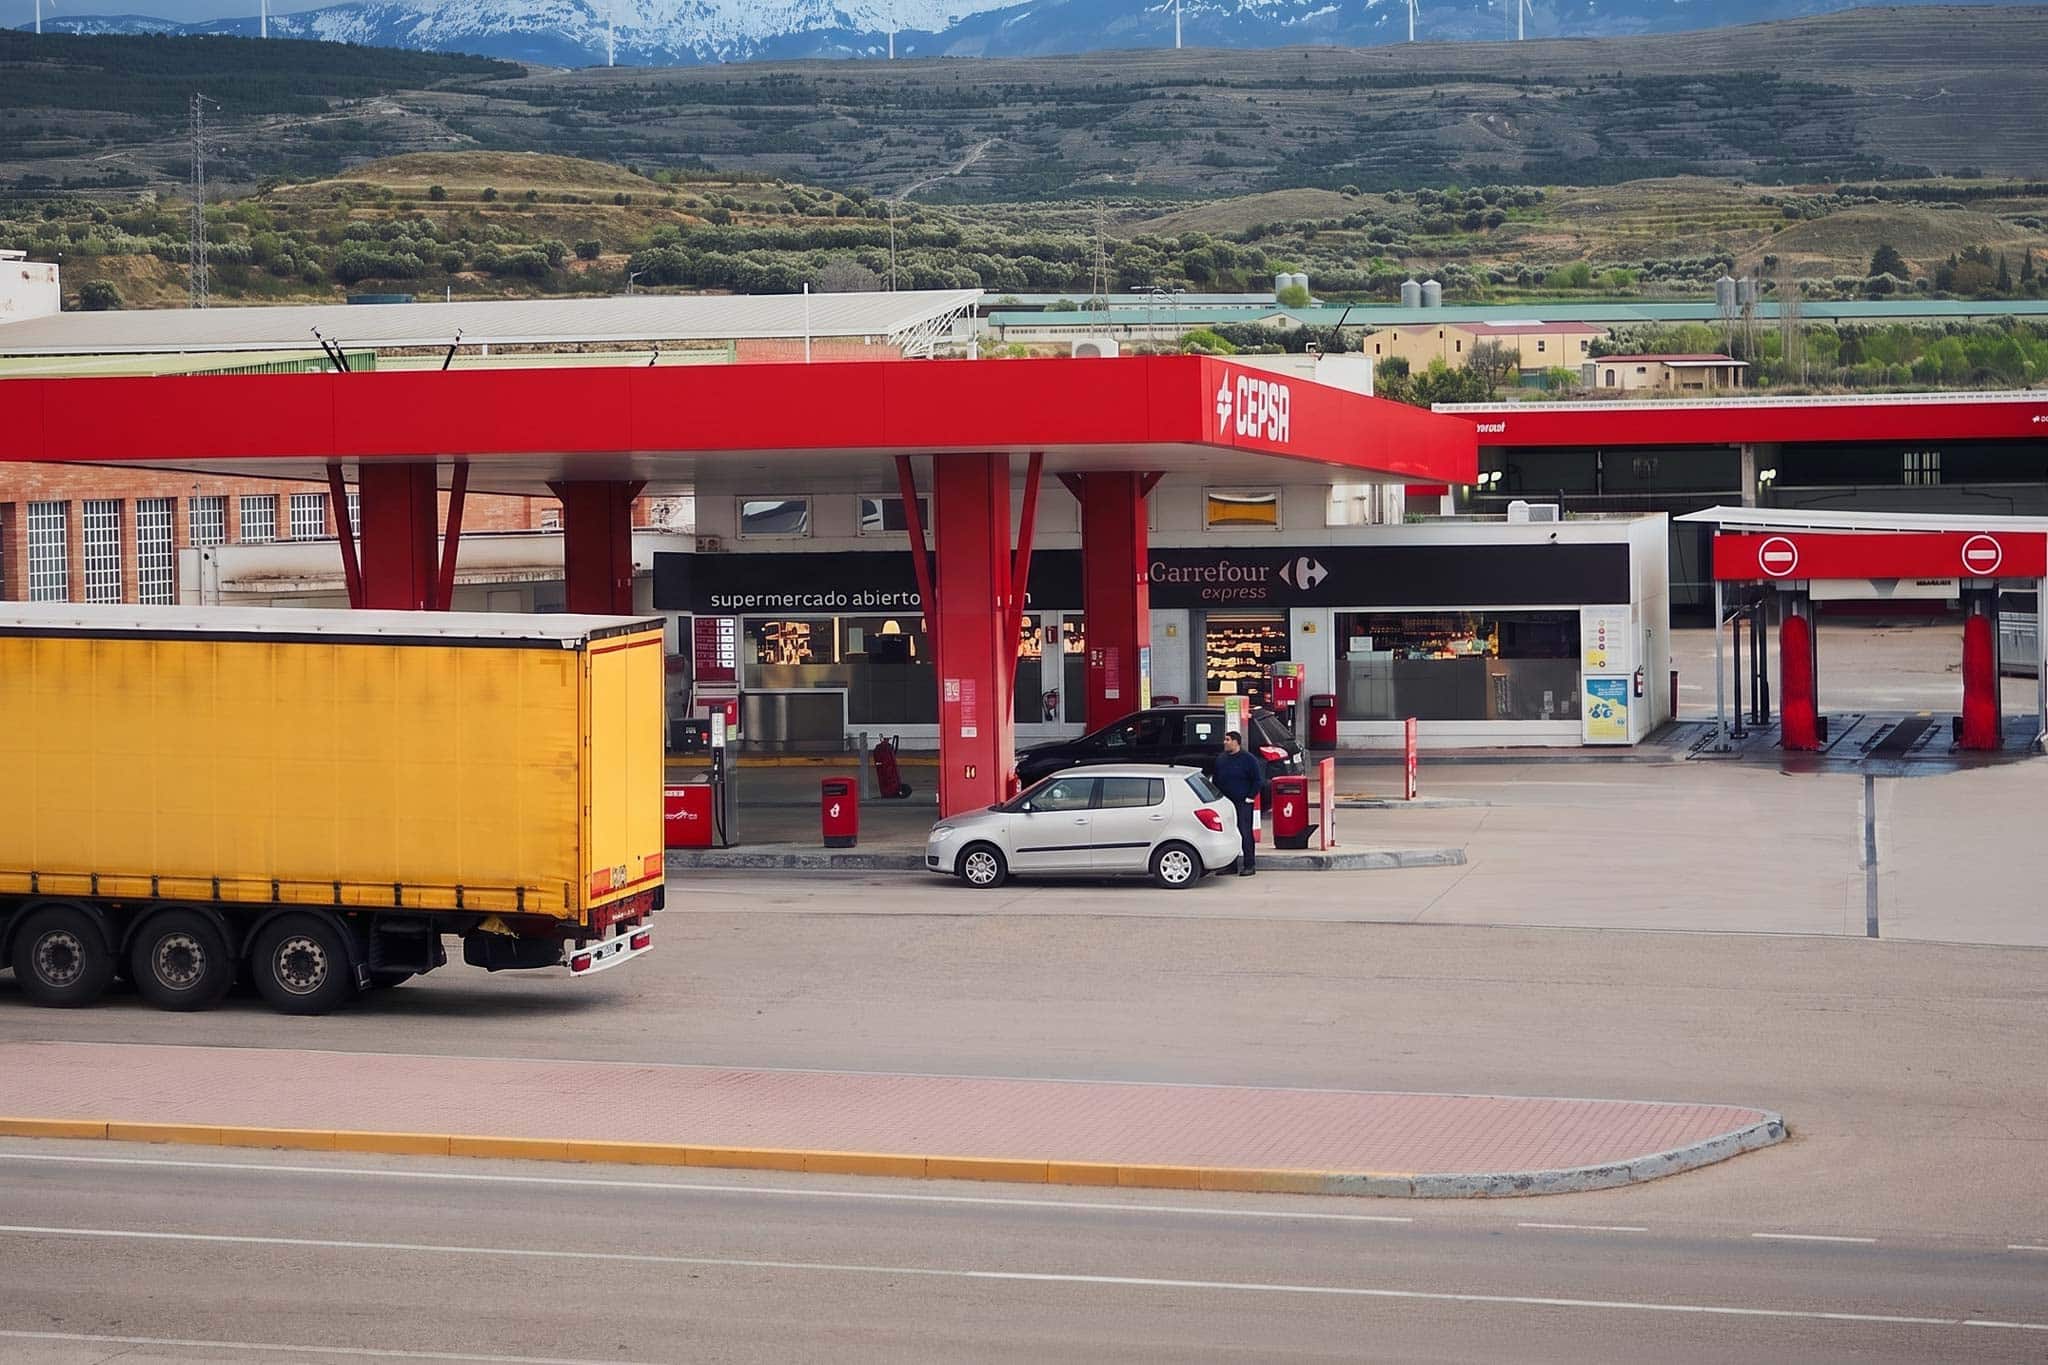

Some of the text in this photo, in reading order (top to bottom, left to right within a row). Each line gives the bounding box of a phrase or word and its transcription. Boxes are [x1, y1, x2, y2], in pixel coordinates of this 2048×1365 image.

[1236, 375, 1290, 443] CEPSA
[1150, 561, 1270, 583] Carrefour
[711, 590, 921, 609] supermercado abierto
[1201, 587, 1267, 602] express
